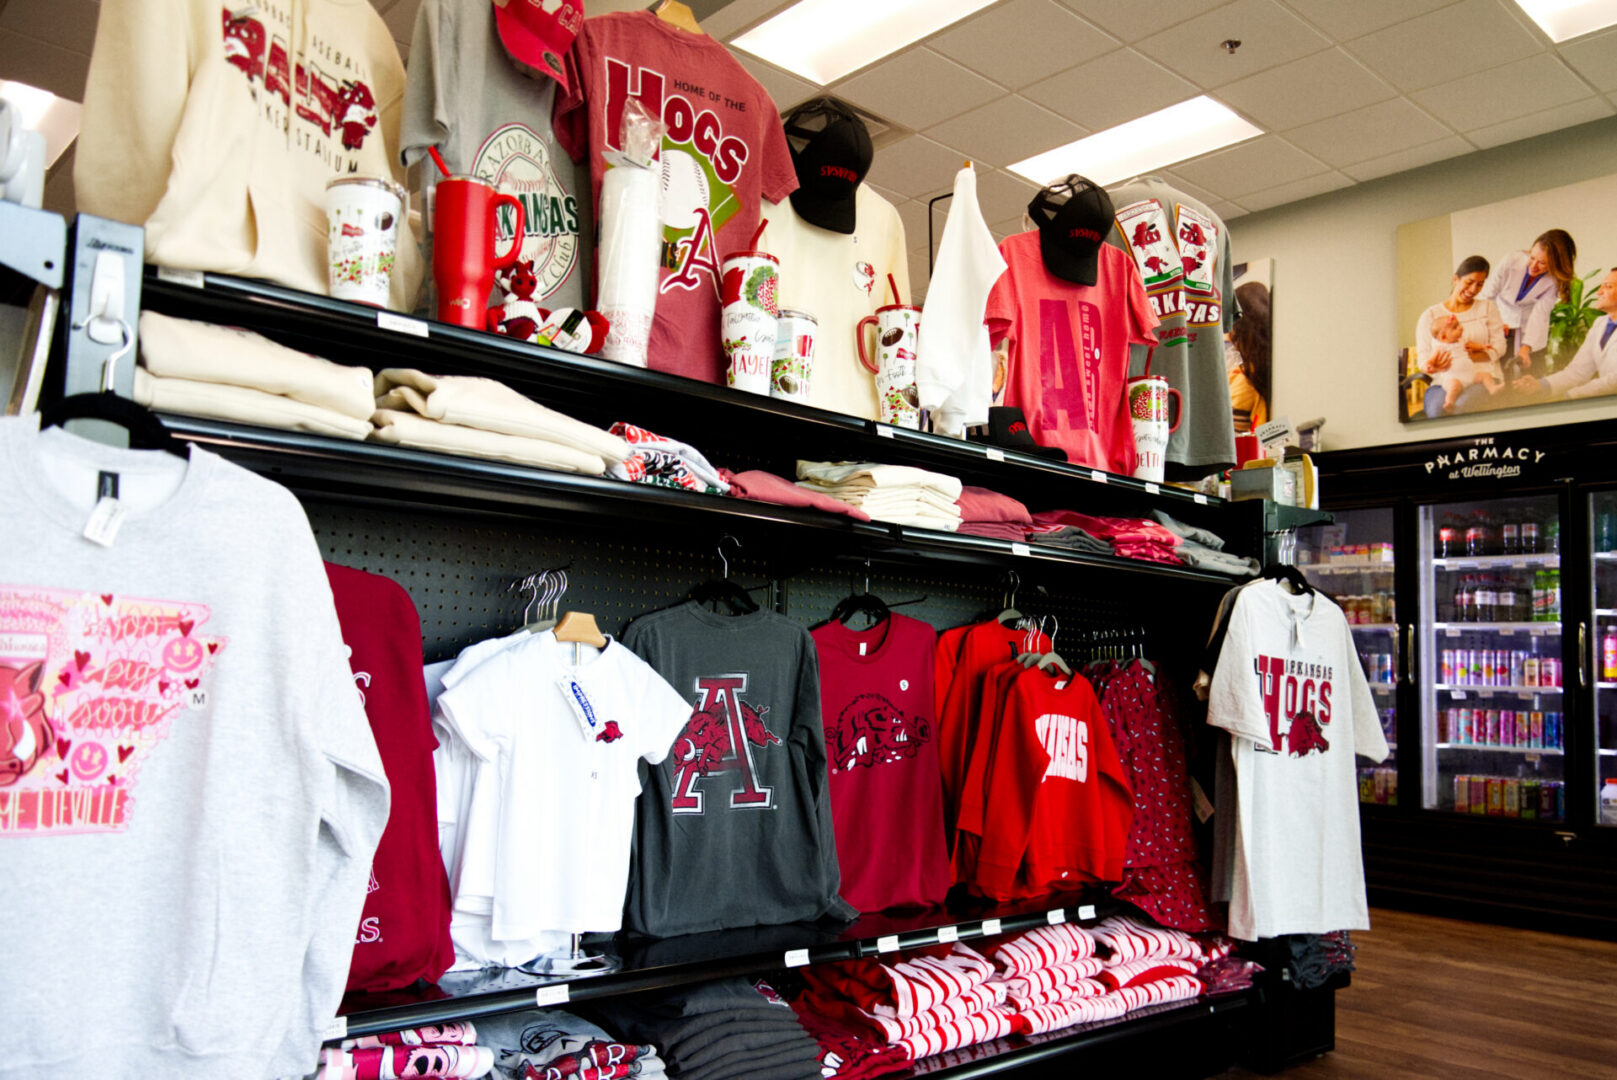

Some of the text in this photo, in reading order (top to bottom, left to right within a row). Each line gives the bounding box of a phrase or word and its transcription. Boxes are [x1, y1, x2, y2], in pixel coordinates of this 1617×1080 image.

[673, 79, 747, 113] HOME OF THE
[604, 56, 749, 185] HOGS
[1474, 437, 1495, 446] THE
[1424, 446, 1546, 474] PHARMACY
[1448, 462, 1521, 480] at Wellington
[1285, 658, 1333, 681] ARKANSAS
[192, 692, 206, 705] M
[1253, 653, 1333, 755] HOGS
